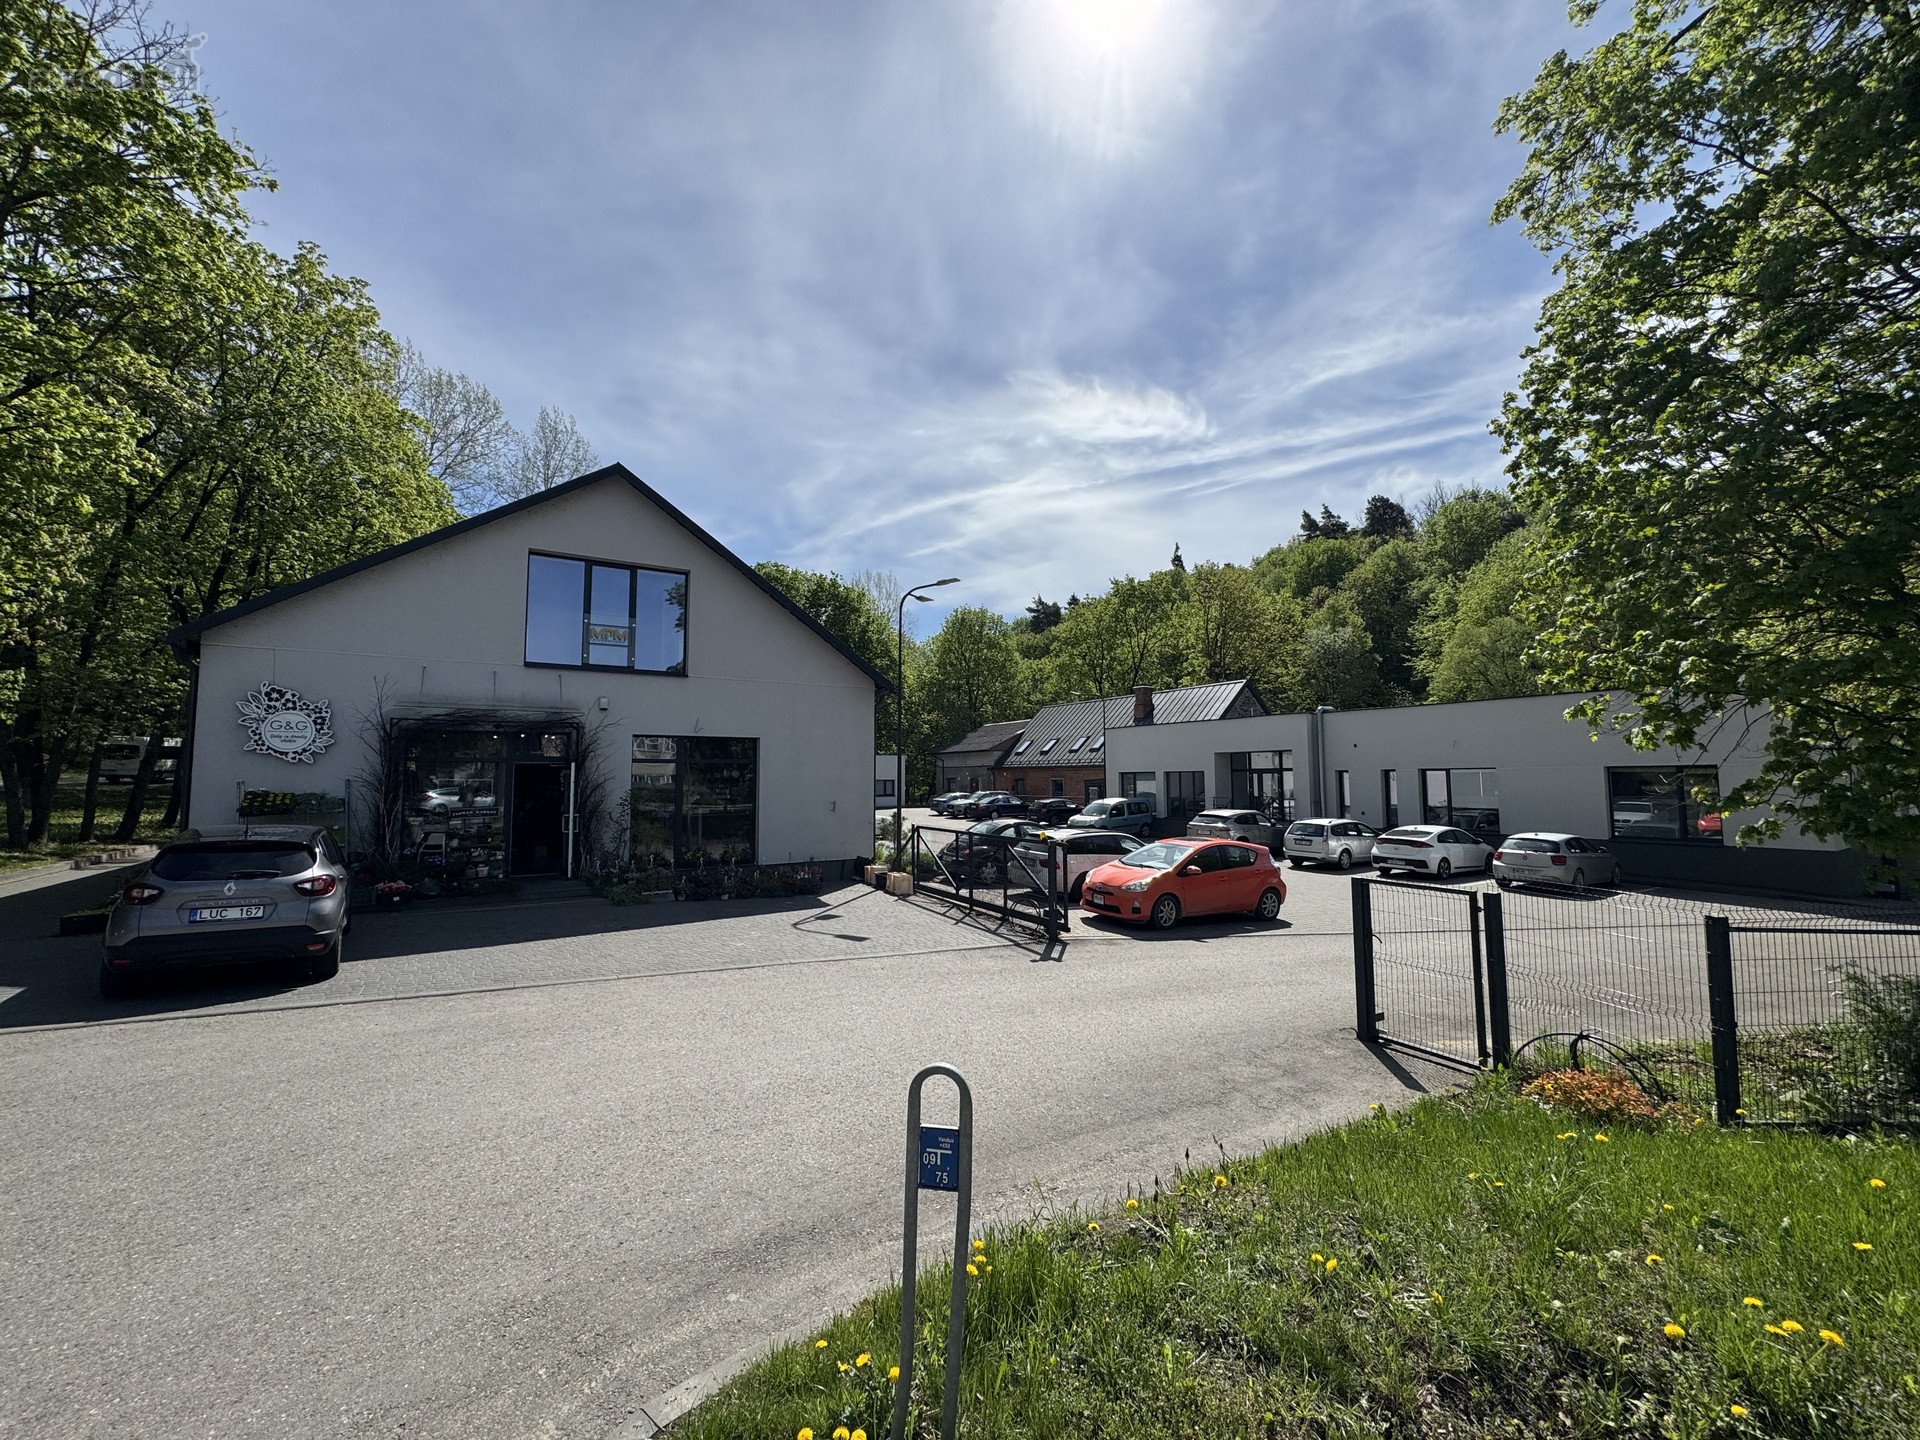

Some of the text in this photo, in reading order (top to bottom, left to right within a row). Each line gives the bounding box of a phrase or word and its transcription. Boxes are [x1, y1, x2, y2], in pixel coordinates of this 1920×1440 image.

[270, 720, 308, 731] G&G
[199, 908, 229, 920] LUC
[239, 906, 262, 917] 167
